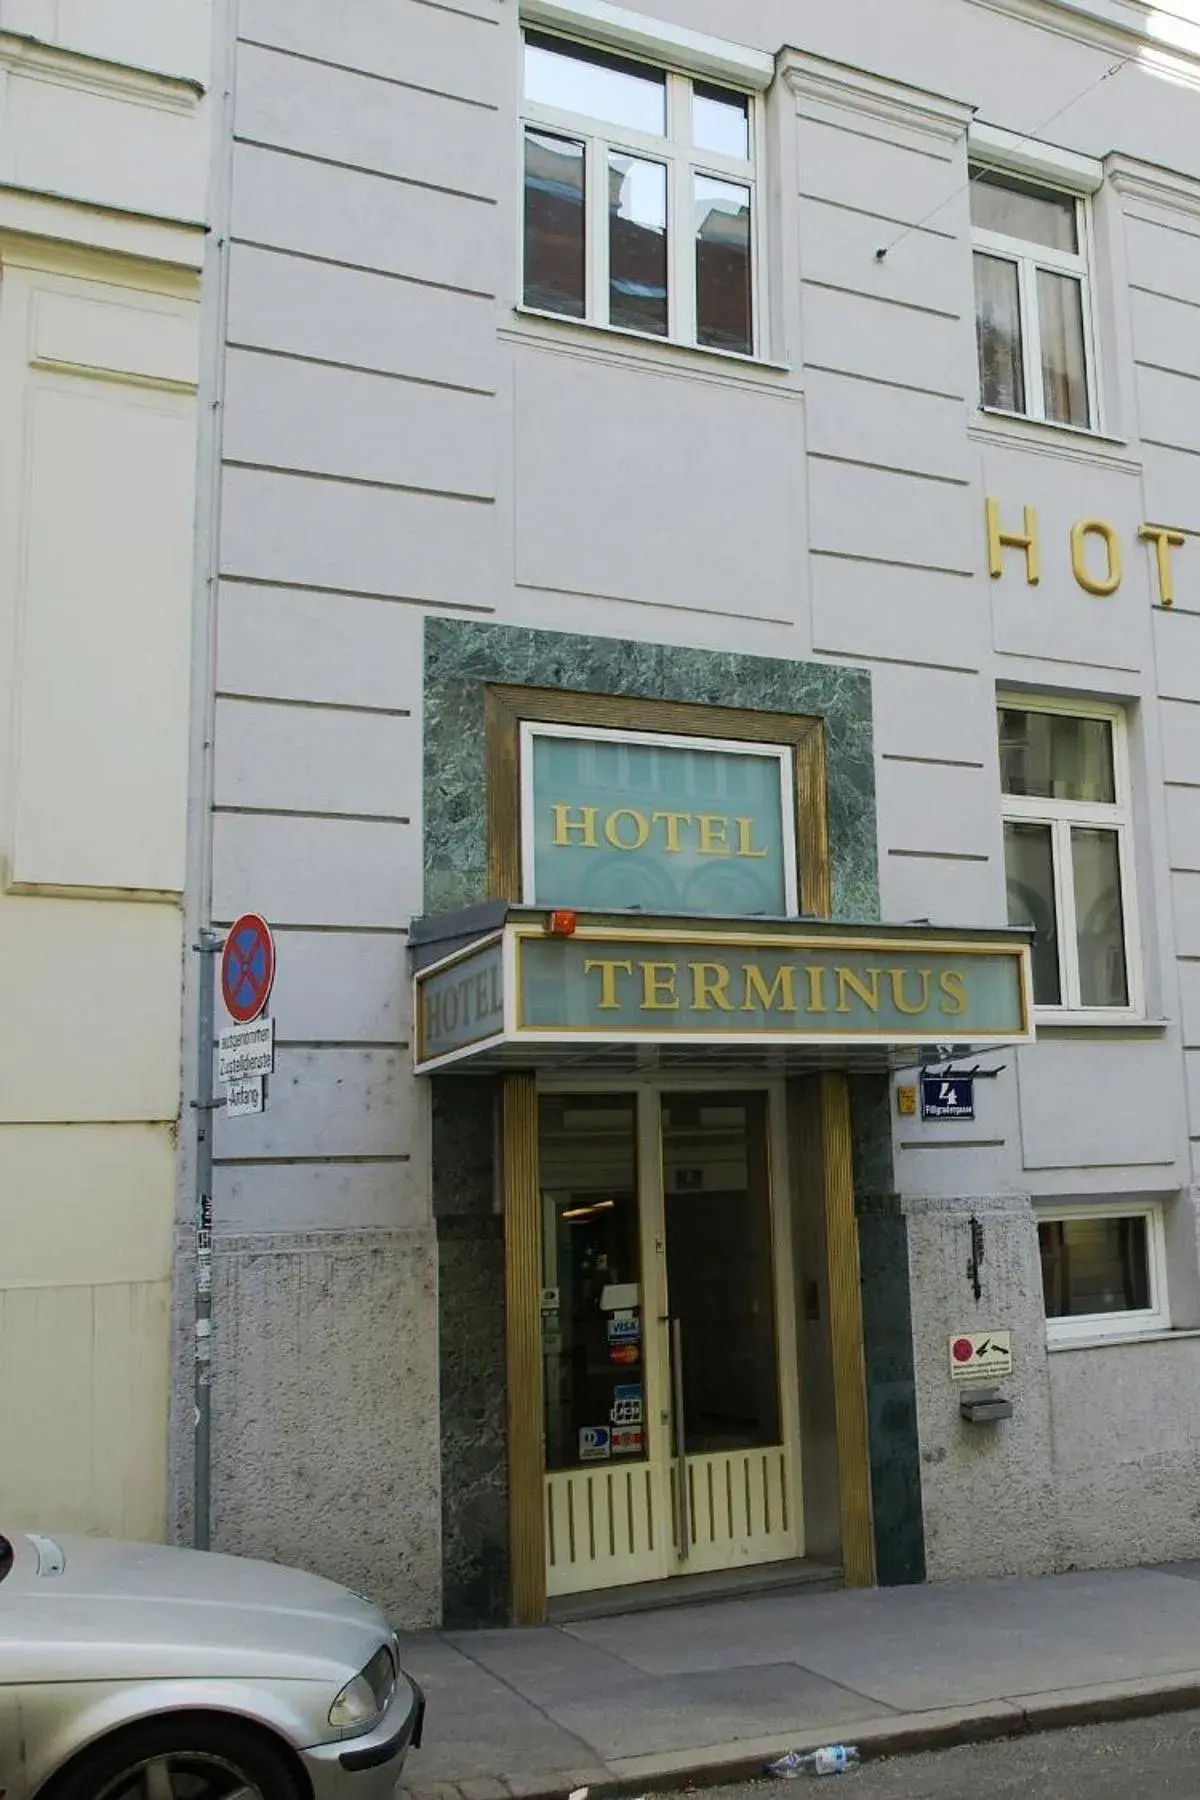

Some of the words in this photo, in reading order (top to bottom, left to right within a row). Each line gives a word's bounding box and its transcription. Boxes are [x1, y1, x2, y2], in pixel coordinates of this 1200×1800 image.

[549, 803, 769, 859] HOTEL
[428, 964, 504, 1039] HOTEL
[584, 958, 970, 1016] TERMINUS
[228, 1086, 259, 1108] Anfang
[939, 1082, 957, 1105] 4
[613, 1321, 637, 1332] VISA
